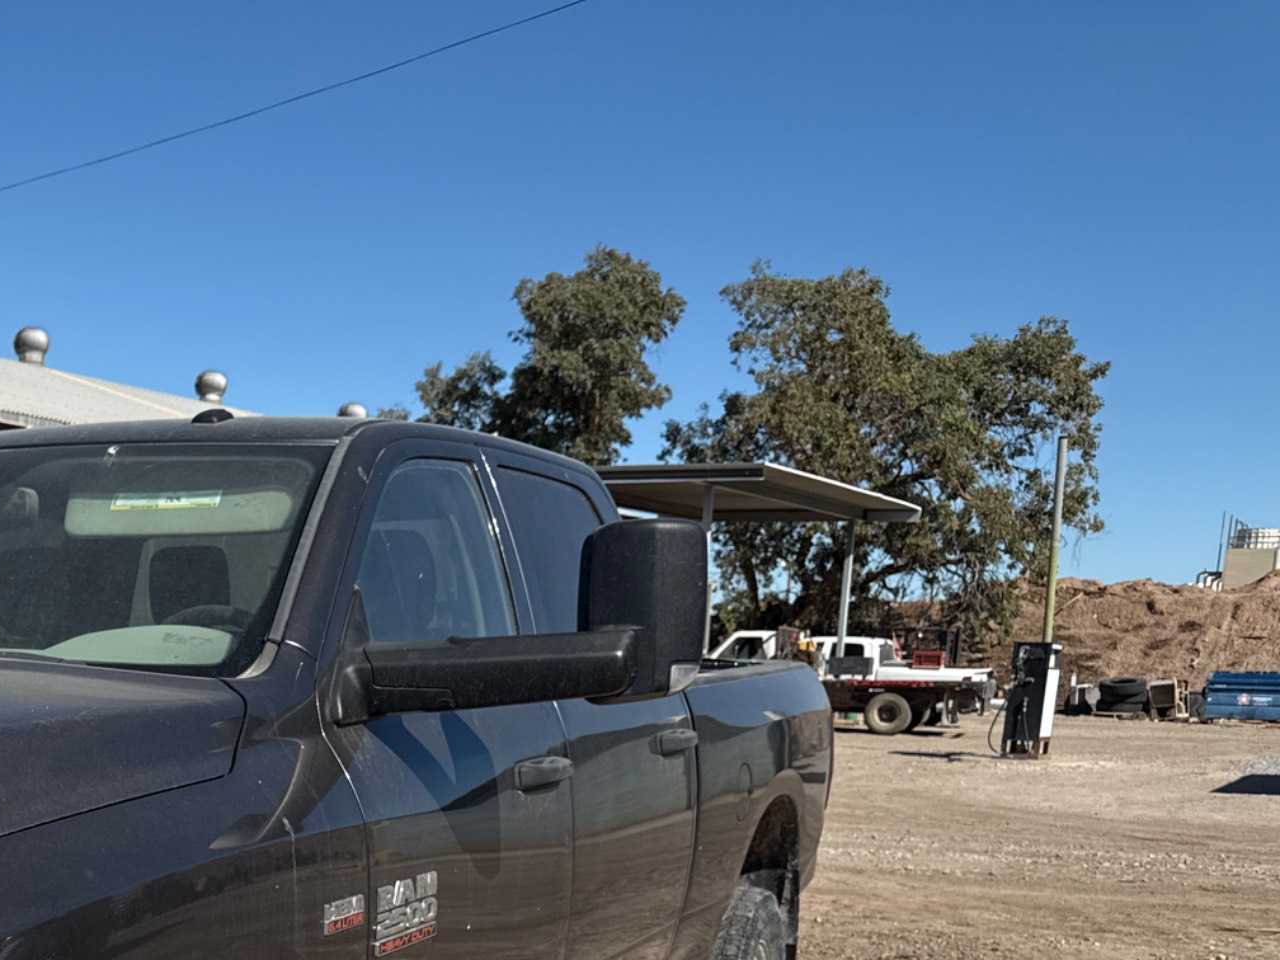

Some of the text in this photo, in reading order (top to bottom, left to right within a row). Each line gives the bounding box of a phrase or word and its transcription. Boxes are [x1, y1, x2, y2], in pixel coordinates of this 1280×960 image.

[376, 870, 438, 912] RAM
[376, 897, 438, 940] 2500
[380, 926, 434, 953] HEAVY DUTY
